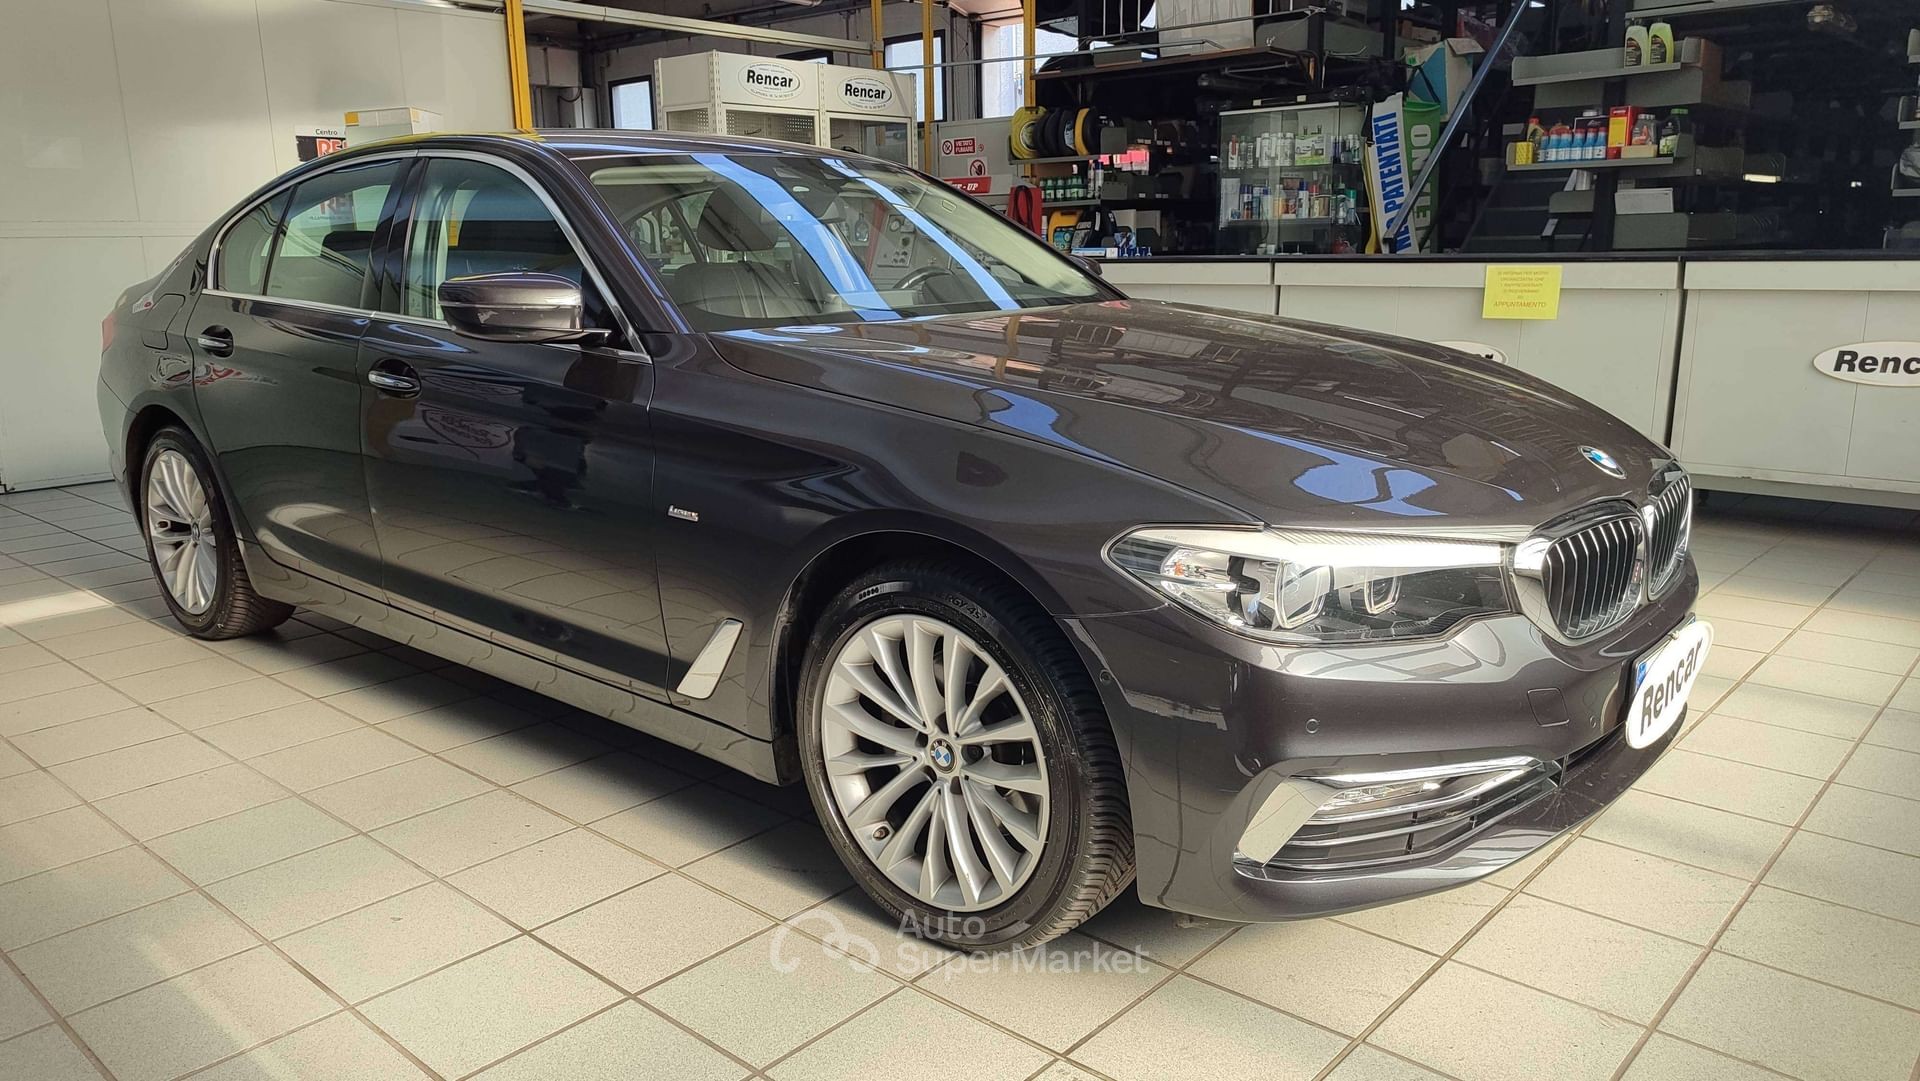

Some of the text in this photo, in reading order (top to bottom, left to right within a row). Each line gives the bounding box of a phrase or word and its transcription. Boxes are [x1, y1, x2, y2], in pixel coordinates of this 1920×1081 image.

[747, 69, 793, 88] Rencar
[845, 83, 886, 99] Rencar
[315, 128, 338, 136] Centro
[1373, 112, 1405, 214] PATENTATI
[1494, 301, 1546, 309] APPUNTAMENTO
[1640, 637, 1703, 736] Rencar
